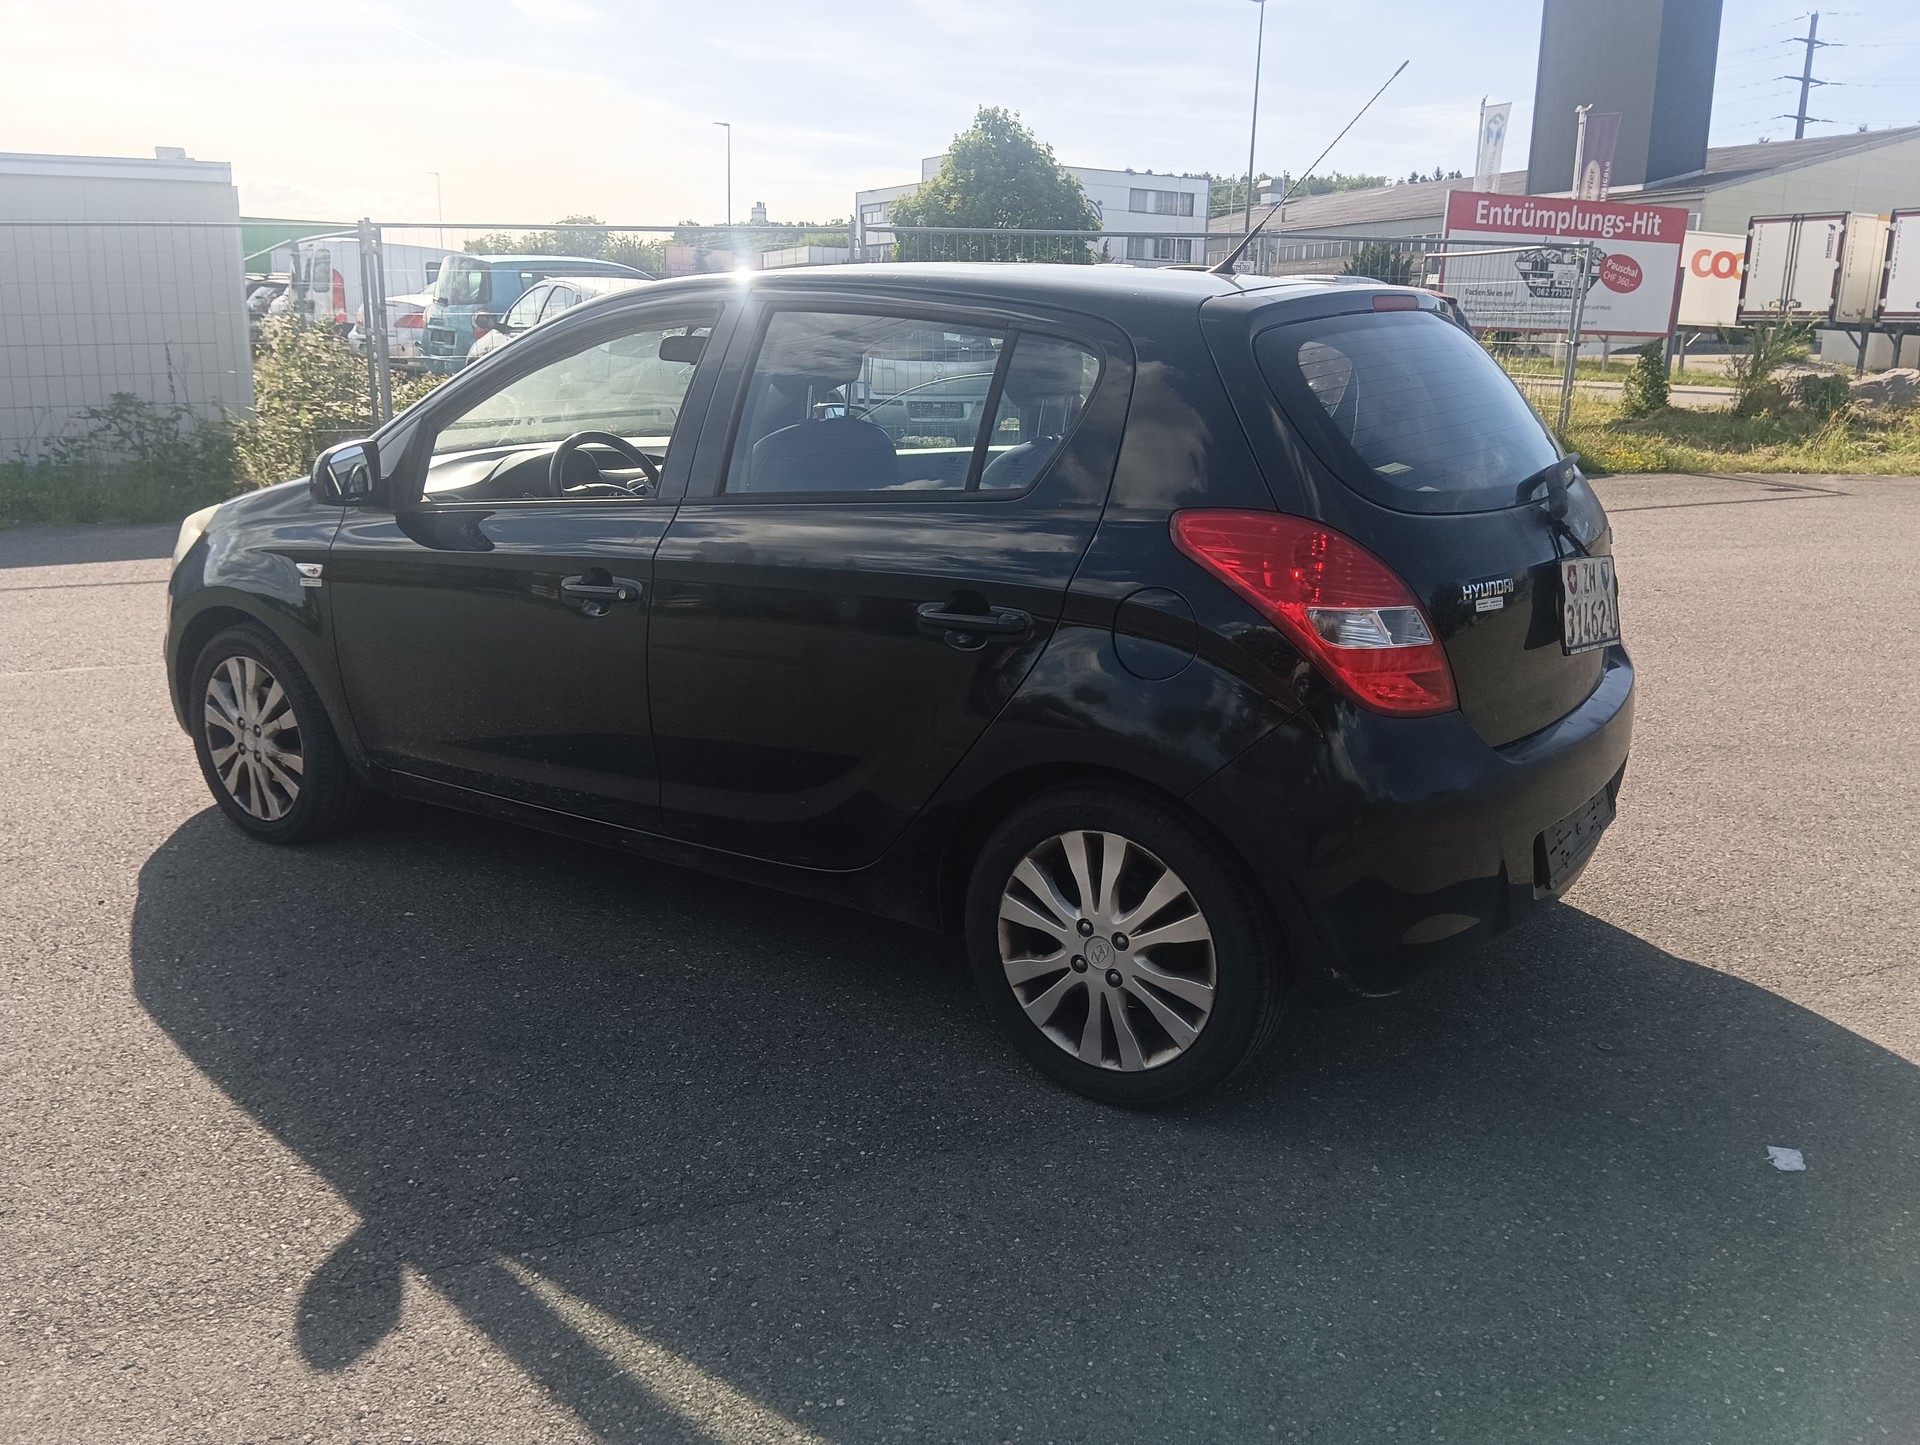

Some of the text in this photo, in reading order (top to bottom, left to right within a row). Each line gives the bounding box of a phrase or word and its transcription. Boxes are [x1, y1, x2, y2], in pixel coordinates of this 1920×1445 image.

[1476, 200, 1662, 238] Entrümplungs-Hit
[1603, 270, 1617, 281] CHF
[1606, 259, 1639, 278] Pauschal
[1462, 578, 1514, 600] HYUNDAI
[1583, 562, 1597, 594] ZH
